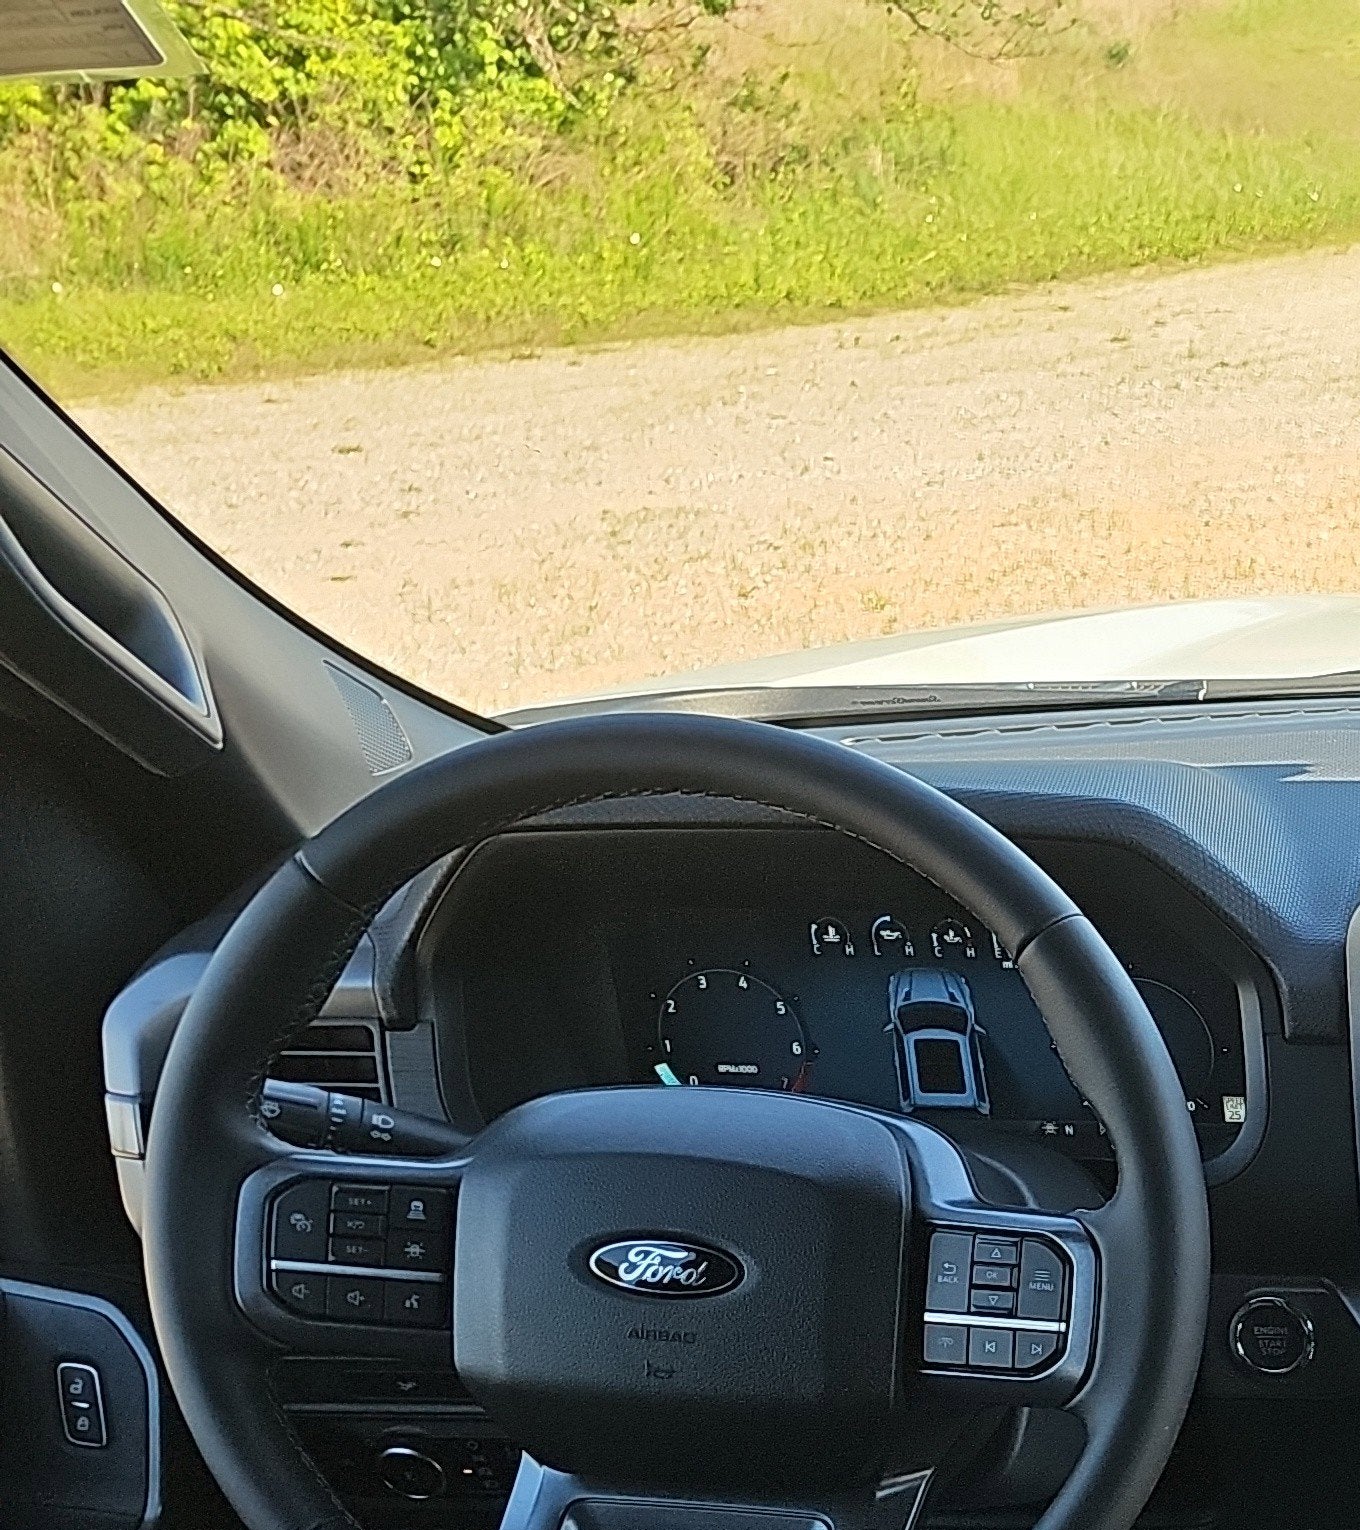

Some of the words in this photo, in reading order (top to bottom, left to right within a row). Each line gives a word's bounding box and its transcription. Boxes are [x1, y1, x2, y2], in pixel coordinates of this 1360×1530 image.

[698, 976, 707, 989] 3
[739, 976, 749, 989] 4
[667, 1000, 676, 1013] 2
[777, 1002, 786, 1015] 5
[665, 1040, 671, 1052] 1
[793, 1042, 802, 1054] 6
[1228, 1111, 1241, 1120] 25
[1064, 1125, 1073, 1135] N
[619, 1246, 709, 1287] Ford
[938, 1275, 960, 1284] BACK
[1030, 1283, 1055, 1292] MENU
[628, 1326, 697, 1344] AIRBAG
